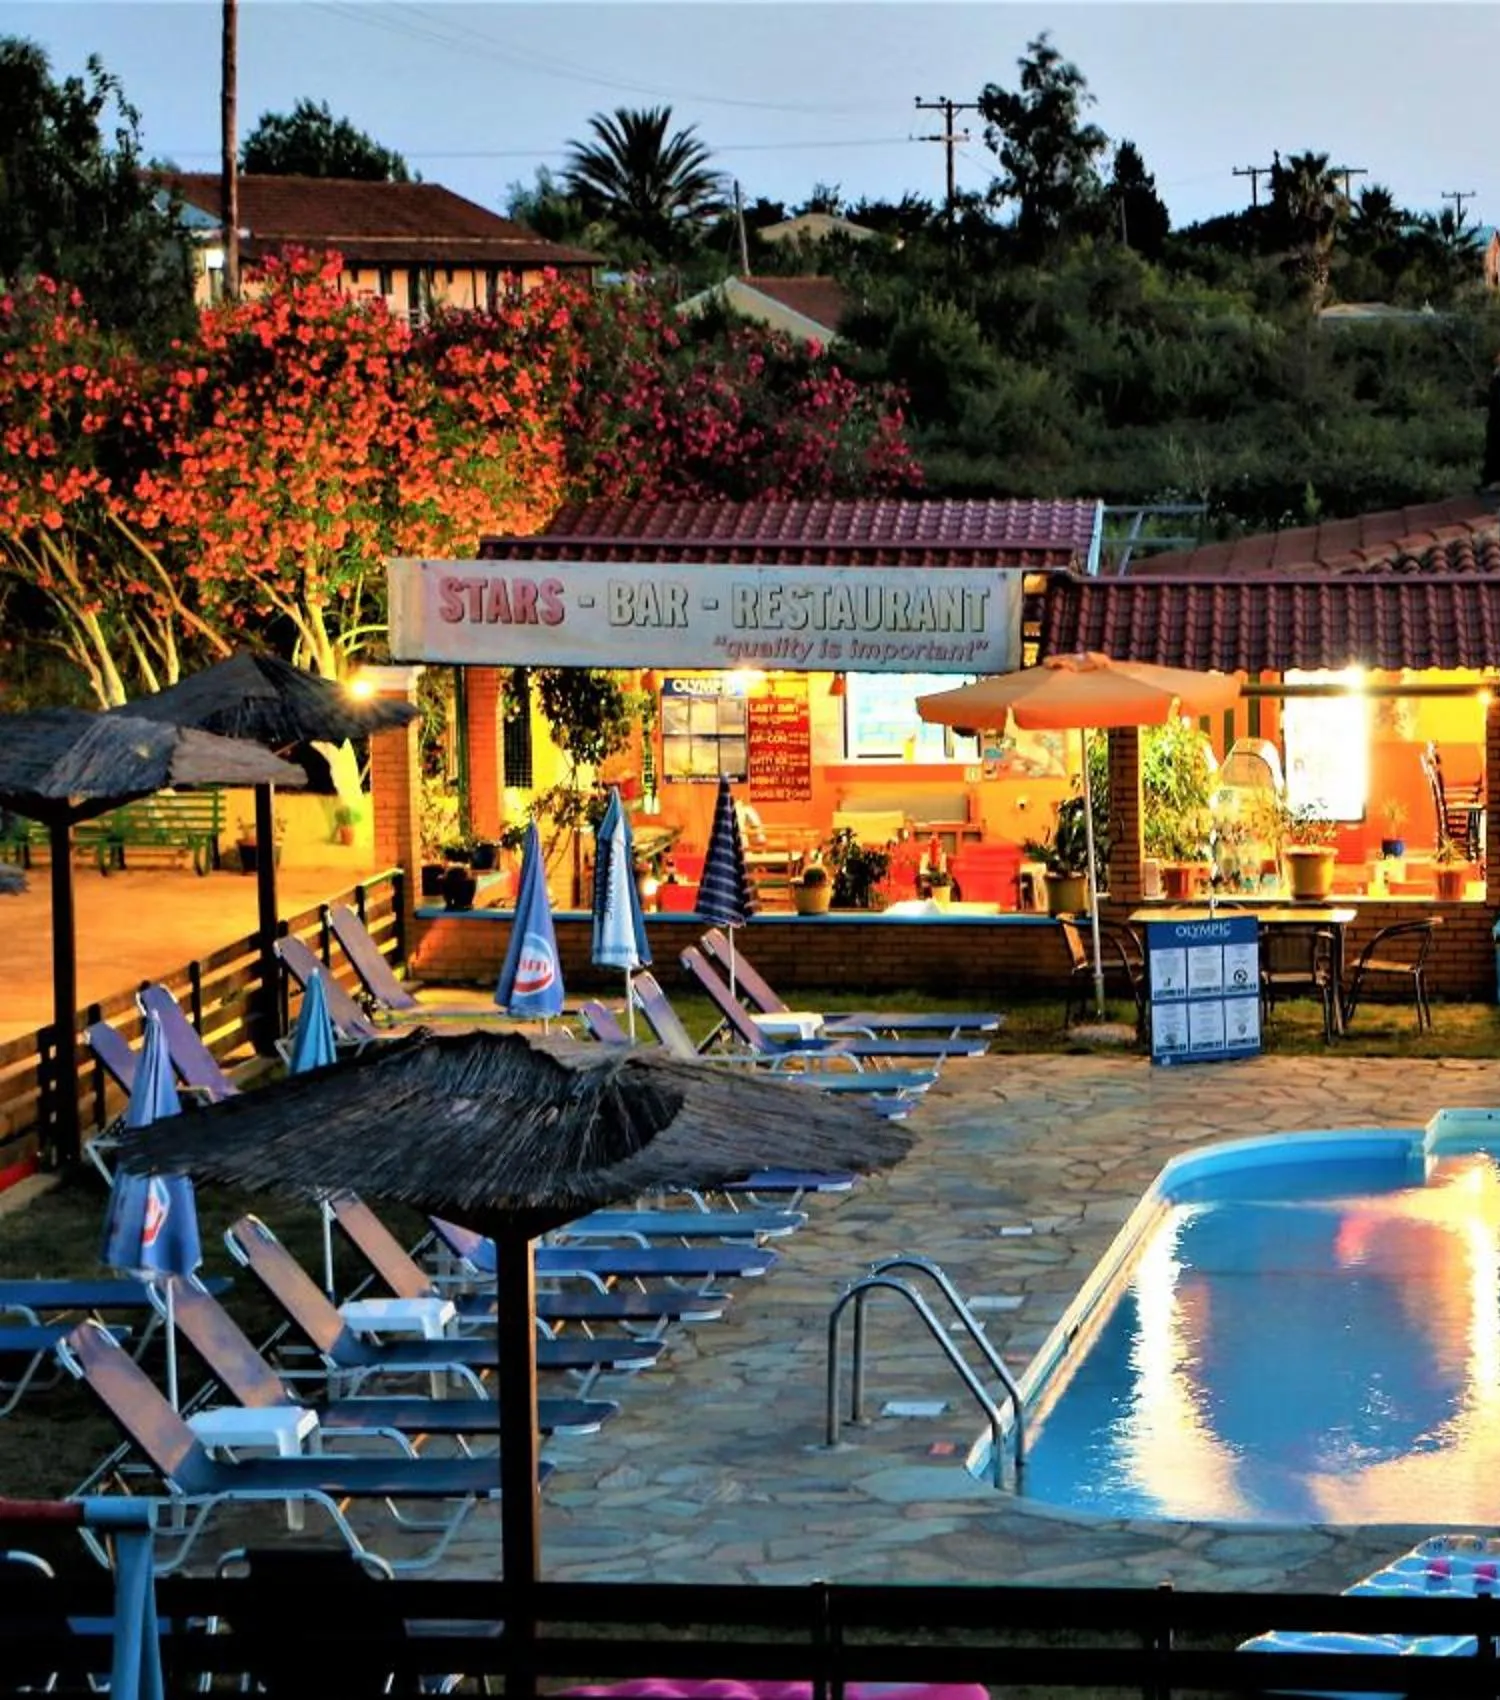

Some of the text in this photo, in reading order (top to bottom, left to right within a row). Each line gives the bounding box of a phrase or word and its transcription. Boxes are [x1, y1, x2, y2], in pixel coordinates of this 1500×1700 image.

[438, 577, 565, 626] STARS
[608, 578, 689, 628] BAR
[731, 581, 991, 633] RESTAURANT
[818, 638, 842, 660] is
[1175, 921, 1232, 938] OLYMPIC
